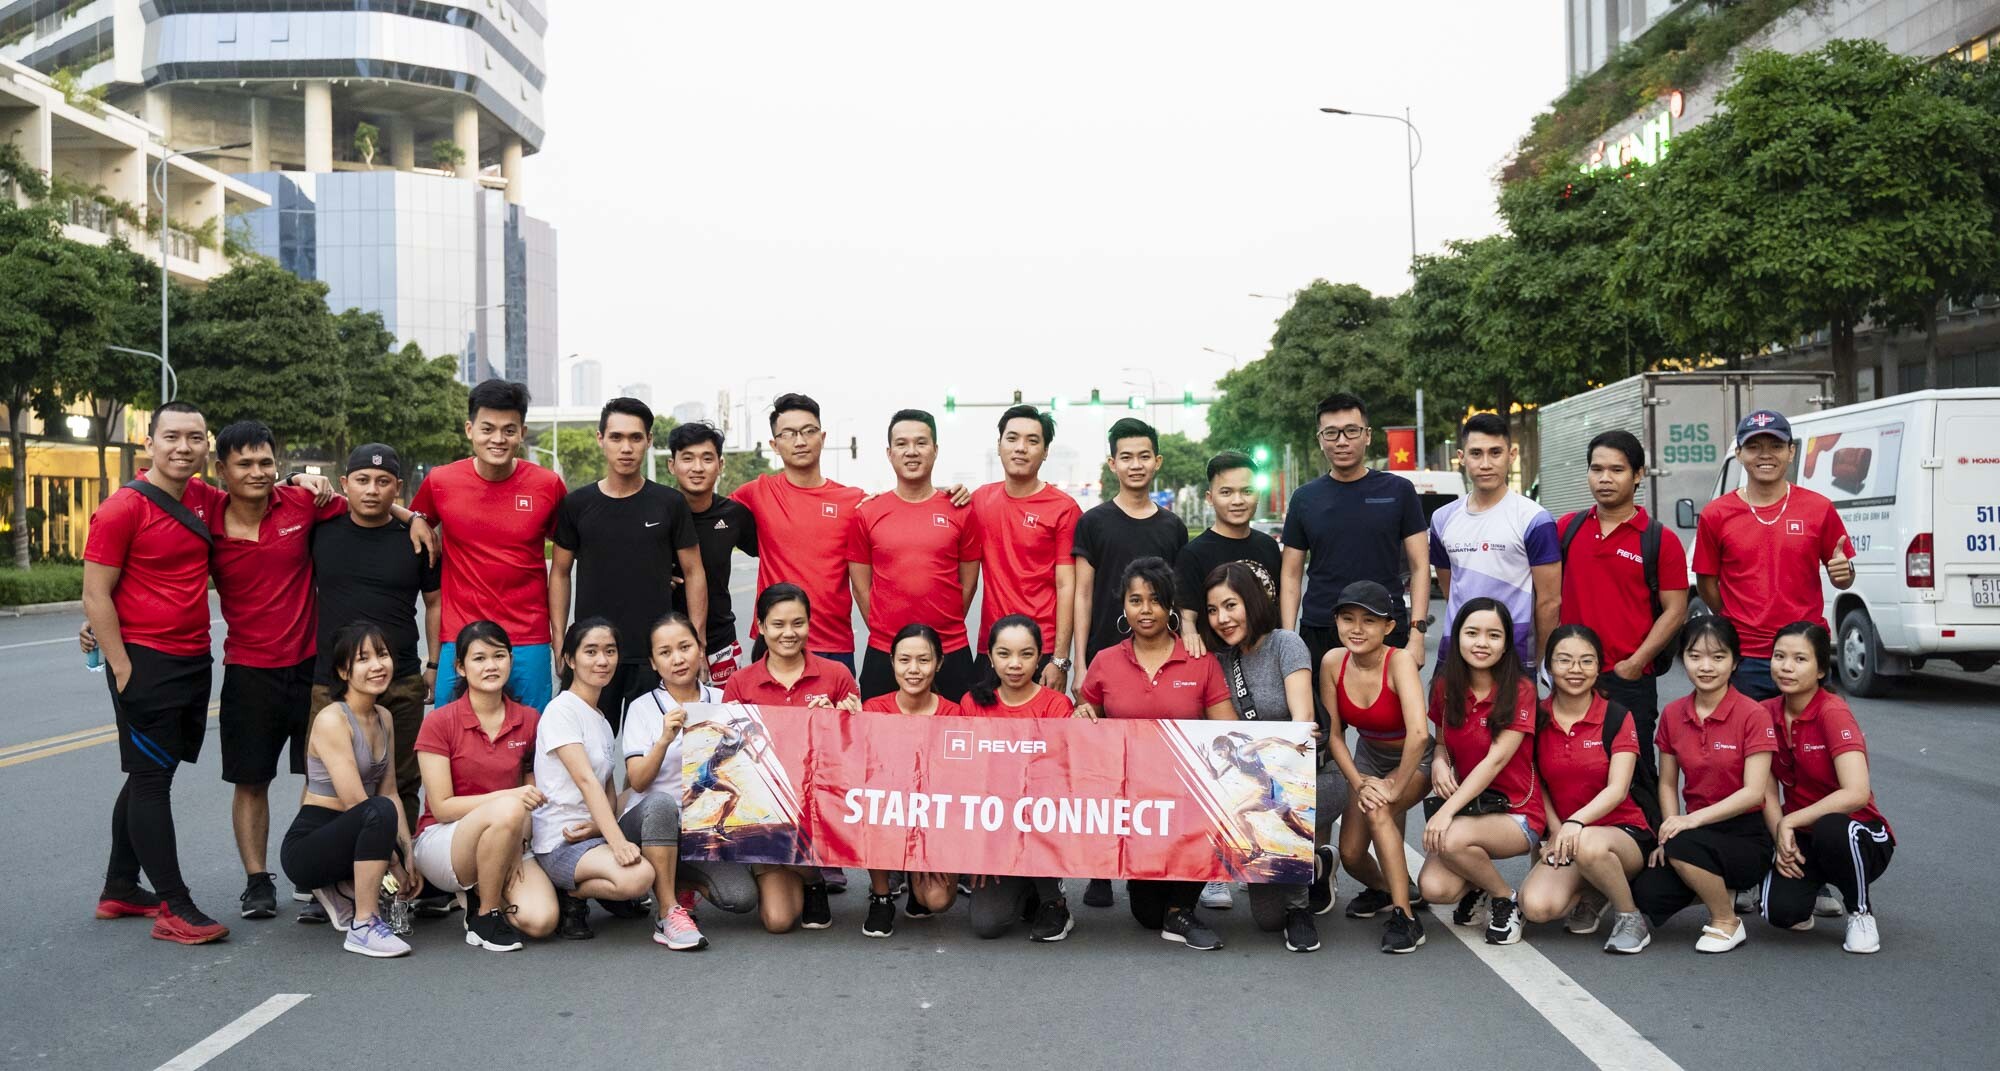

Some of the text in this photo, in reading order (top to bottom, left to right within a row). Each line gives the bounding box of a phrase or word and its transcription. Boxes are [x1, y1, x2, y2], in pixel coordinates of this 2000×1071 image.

[1669, 423, 1710, 442] 54S
[1663, 444, 1717, 464] 9999
[951, 738, 1047, 754] R REVER
[843, 787, 1176, 836] START TO CONNECT
